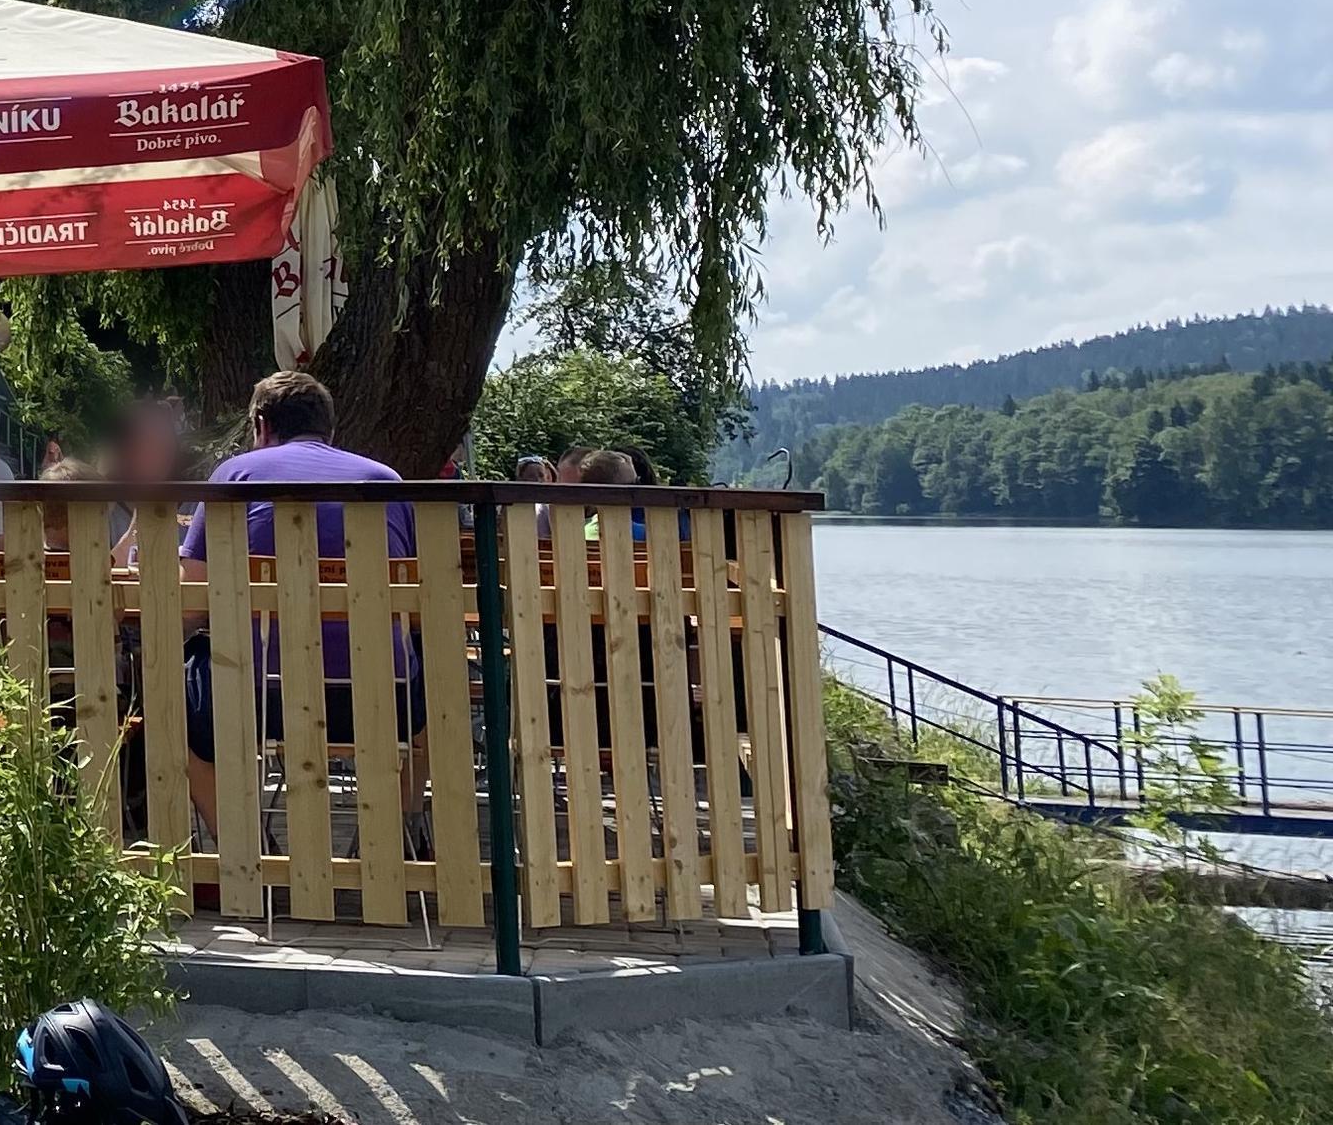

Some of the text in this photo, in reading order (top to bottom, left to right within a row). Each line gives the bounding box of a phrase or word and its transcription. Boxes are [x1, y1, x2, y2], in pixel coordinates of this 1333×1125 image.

[158, 81, 201, 94] 1454
[114, 92, 246, 127] Bakalář
[137, 132, 222, 152] Dobré pivo.
